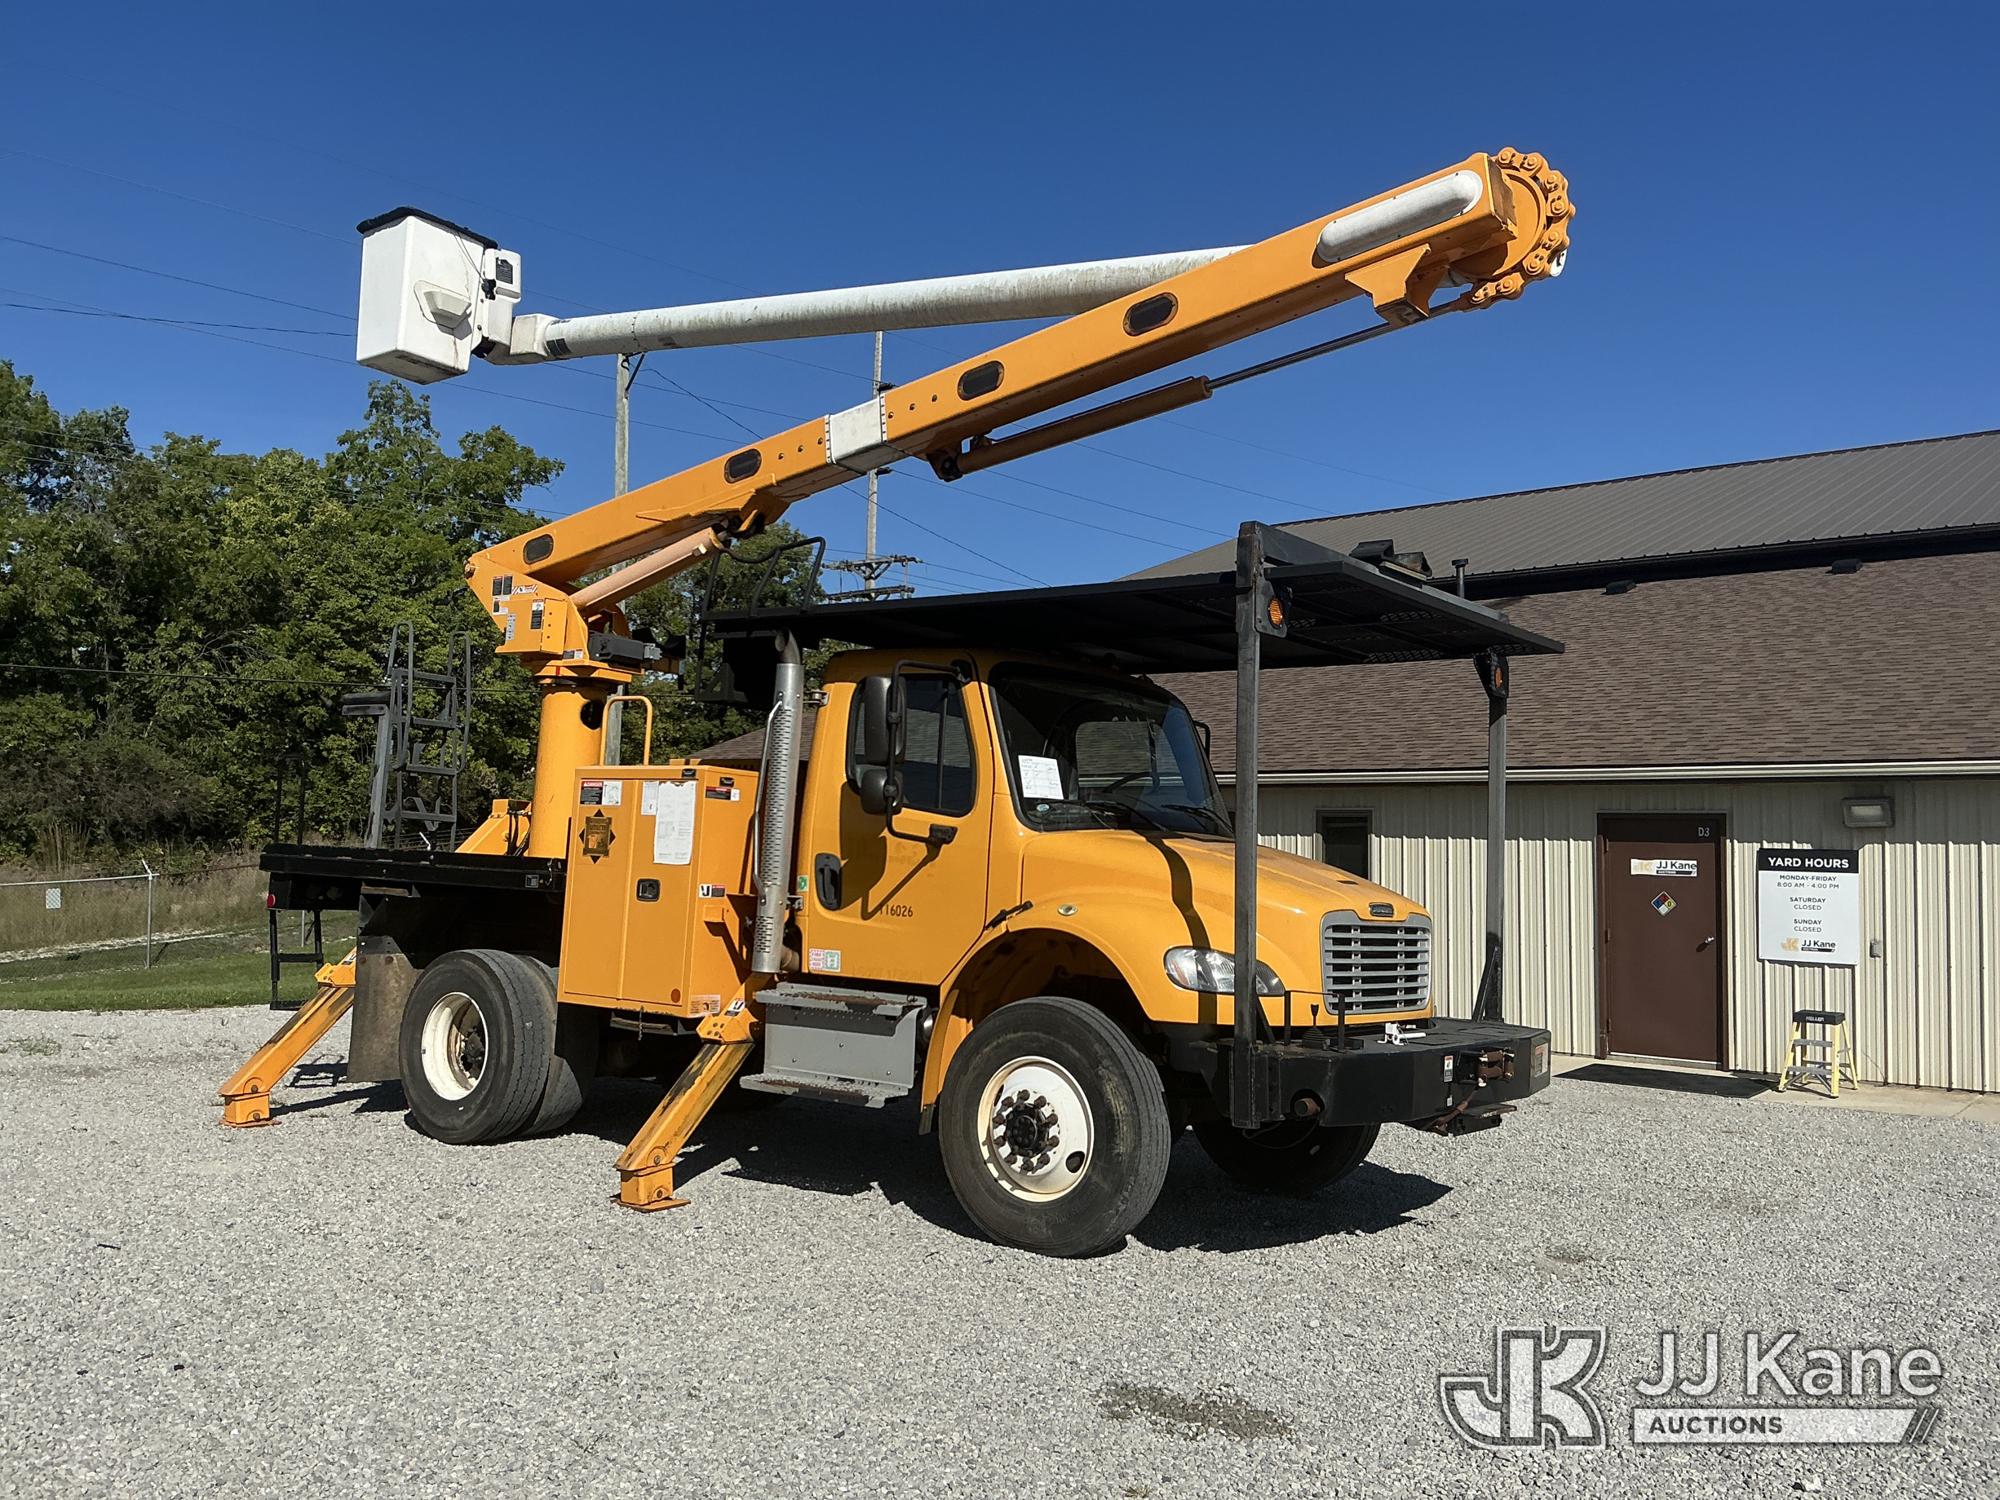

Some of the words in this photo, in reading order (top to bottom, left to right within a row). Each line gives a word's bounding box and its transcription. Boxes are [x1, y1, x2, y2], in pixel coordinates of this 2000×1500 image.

[1698, 827, 1710, 837] D3
[1656, 861, 1668, 869] JJ
[1670, 861, 1697, 870] Kane
[1768, 857, 1801, 867] YARD
[1805, 858, 1849, 868] HOURS
[1779, 874, 1837, 882] MONDAY-FRIDAY
[1813, 940, 1836, 948] Kane
